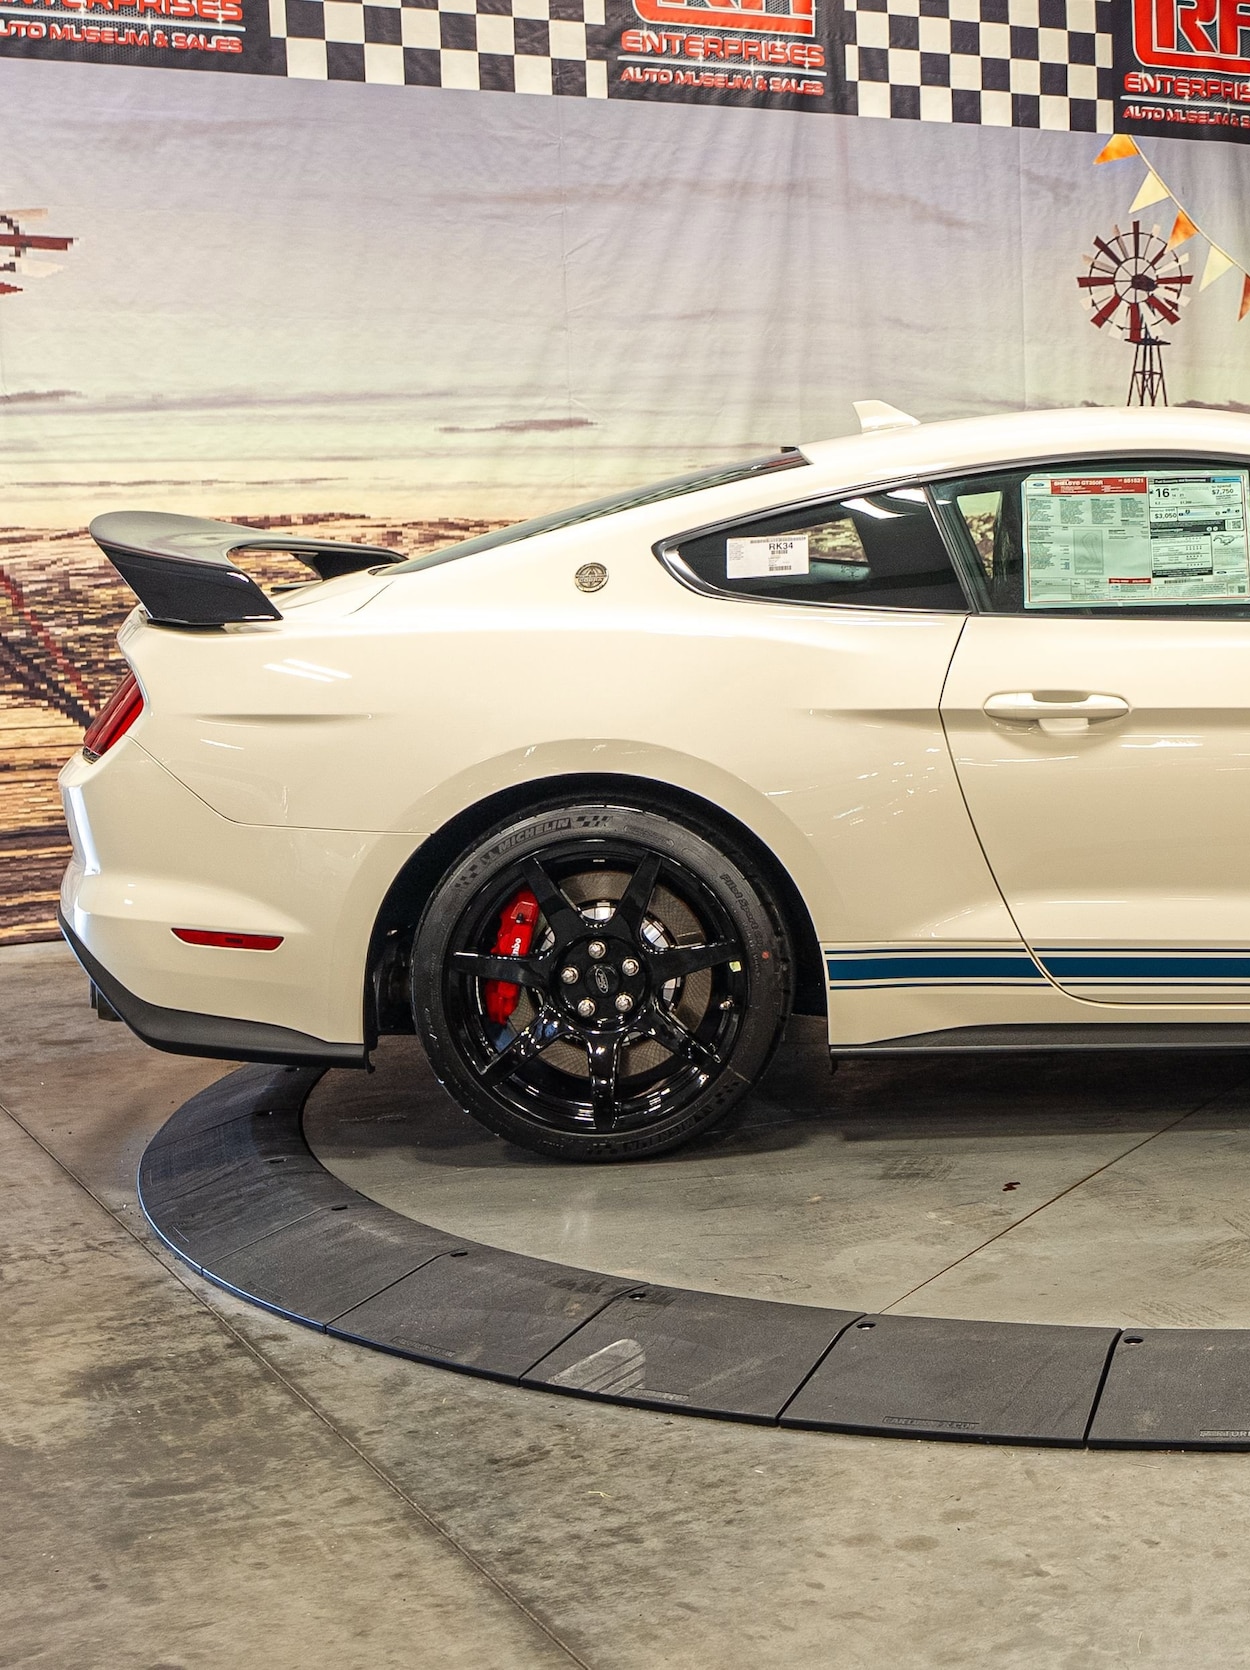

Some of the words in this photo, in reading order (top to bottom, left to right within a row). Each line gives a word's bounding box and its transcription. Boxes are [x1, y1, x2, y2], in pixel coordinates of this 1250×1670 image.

[0, 19, 47, 39] UTO
[49, 24, 149, 47] MUSEUM
[152, 30, 169, 48] &
[172, 32, 243, 53] SALES
[620, 29, 826, 67] ENTERPRISES
[620, 66, 673, 85] AUTO
[674, 70, 753, 91] MUSEUM
[755, 75, 768, 92] &
[769, 77, 825, 96] SALES
[1123, 105, 1165, 121] AUTO
[1166, 108, 1230, 126] MUSEUM
[1230, 113, 1240, 127] &
[1155, 488, 1170, 498] 16
[768, 542, 794, 551] RK34
[501, 817, 571, 850] MICHELIN
